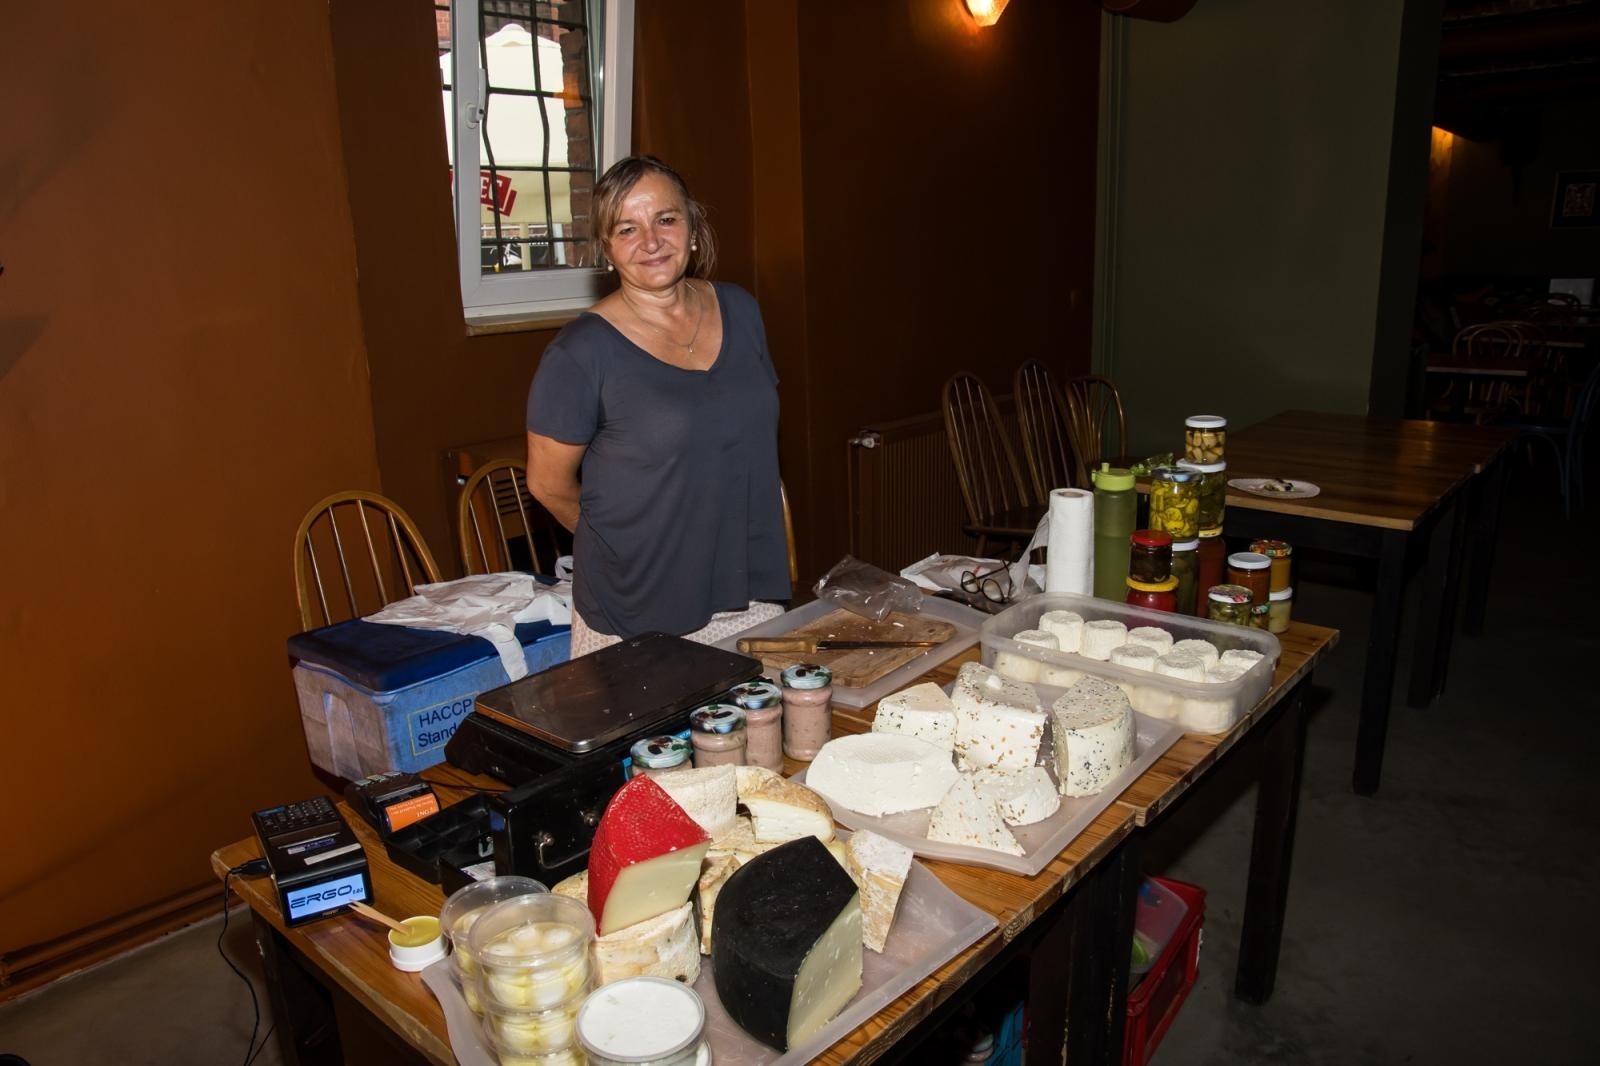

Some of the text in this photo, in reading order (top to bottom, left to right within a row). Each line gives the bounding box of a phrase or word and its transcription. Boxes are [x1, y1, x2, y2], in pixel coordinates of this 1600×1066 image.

[418, 698, 472, 728] HACCP
[417, 722, 457, 747] Stand
[290, 884, 353, 909] ERGO
